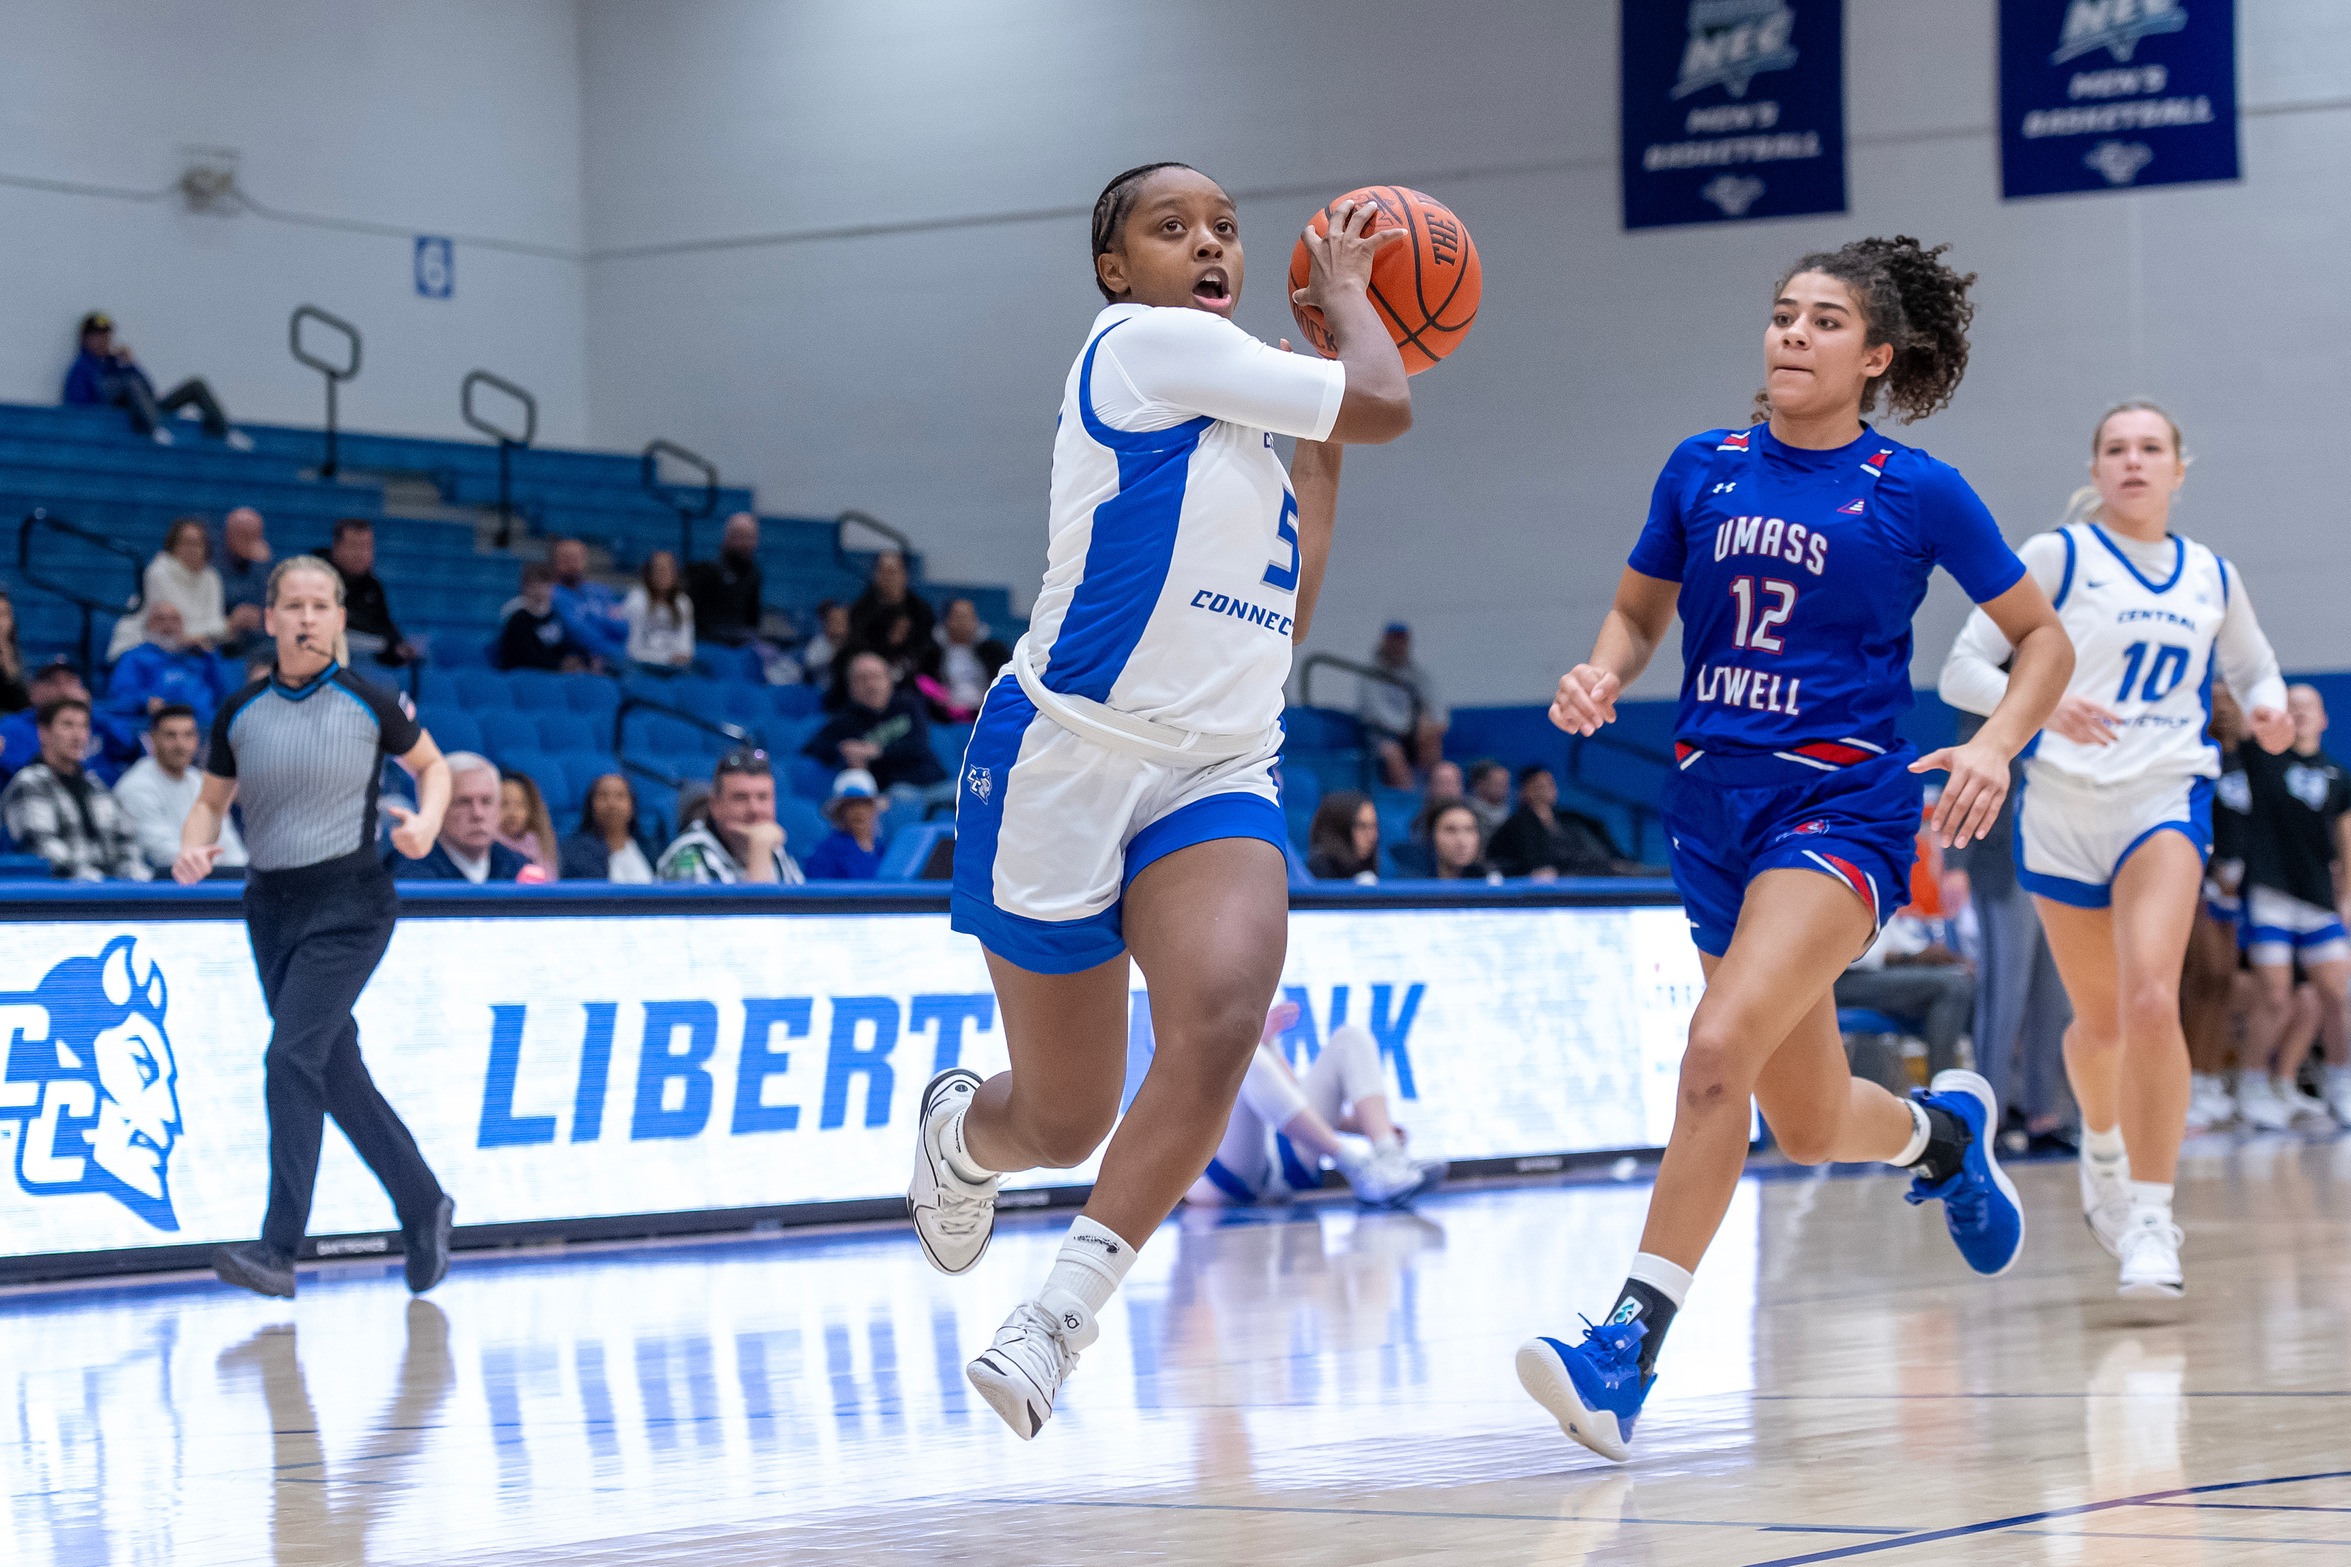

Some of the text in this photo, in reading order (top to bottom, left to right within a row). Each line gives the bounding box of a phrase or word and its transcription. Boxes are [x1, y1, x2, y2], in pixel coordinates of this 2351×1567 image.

[1423, 212, 1459, 268] THE
[1259, 482, 1302, 596] 5
[1713, 516, 1828, 576] UMASS
[1190, 588, 1294, 638] CONNEC
[1729, 575, 1798, 655] 12
[2117, 609, 2197, 633] CENTRAL
[2115, 640, 2191, 703] 10
[477, 993, 996, 1149] LIBERT
